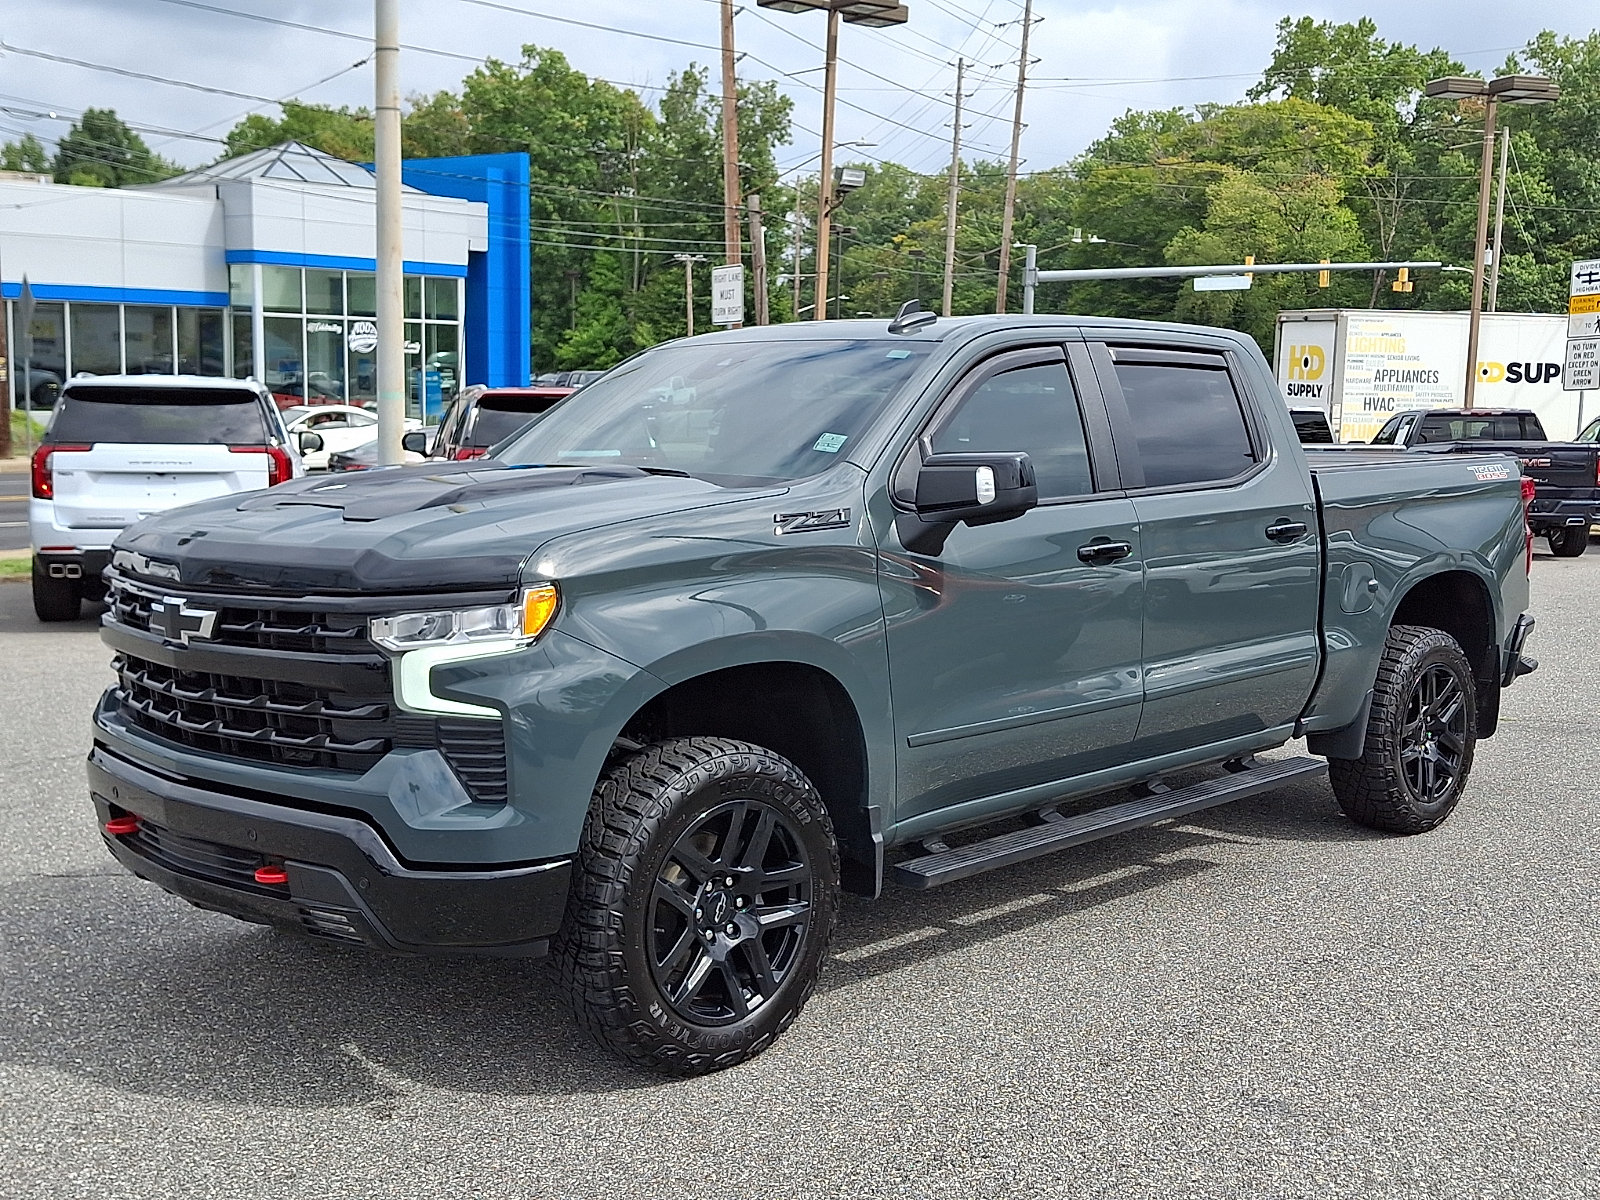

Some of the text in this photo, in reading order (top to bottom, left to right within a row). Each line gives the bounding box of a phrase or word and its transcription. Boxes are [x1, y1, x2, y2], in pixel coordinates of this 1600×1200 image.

[728, 272, 741, 282] LANE
[720, 289, 735, 300] MUST
[714, 305, 741, 316] TURN RIGHT
[1572, 304, 1595, 312] VEHICLES
[1347, 337, 1406, 353] LIGHTING
[1573, 351, 1595, 360] ON RED
[1288, 345, 1326, 381] HD
[1568, 361, 1589, 369] EXCEPT
[1374, 369, 1439, 384] APPLIANCES
[1505, 362, 1565, 384] SUP
[1573, 369, 1592, 377] GREEN
[1572, 378, 1592, 386] ARROW
[1286, 382, 1323, 398] SUPPLY
[1374, 384, 1415, 392] MULTIFAMILY
[1363, 397, 1395, 411] HVAC
[1466, 463, 1510, 474] TRAIL
[1520, 459, 1551, 467] MC
[1476, 472, 1509, 480] BOSS
[773, 507, 851, 536] Z71
[718, 776, 813, 827] WRANGLER
